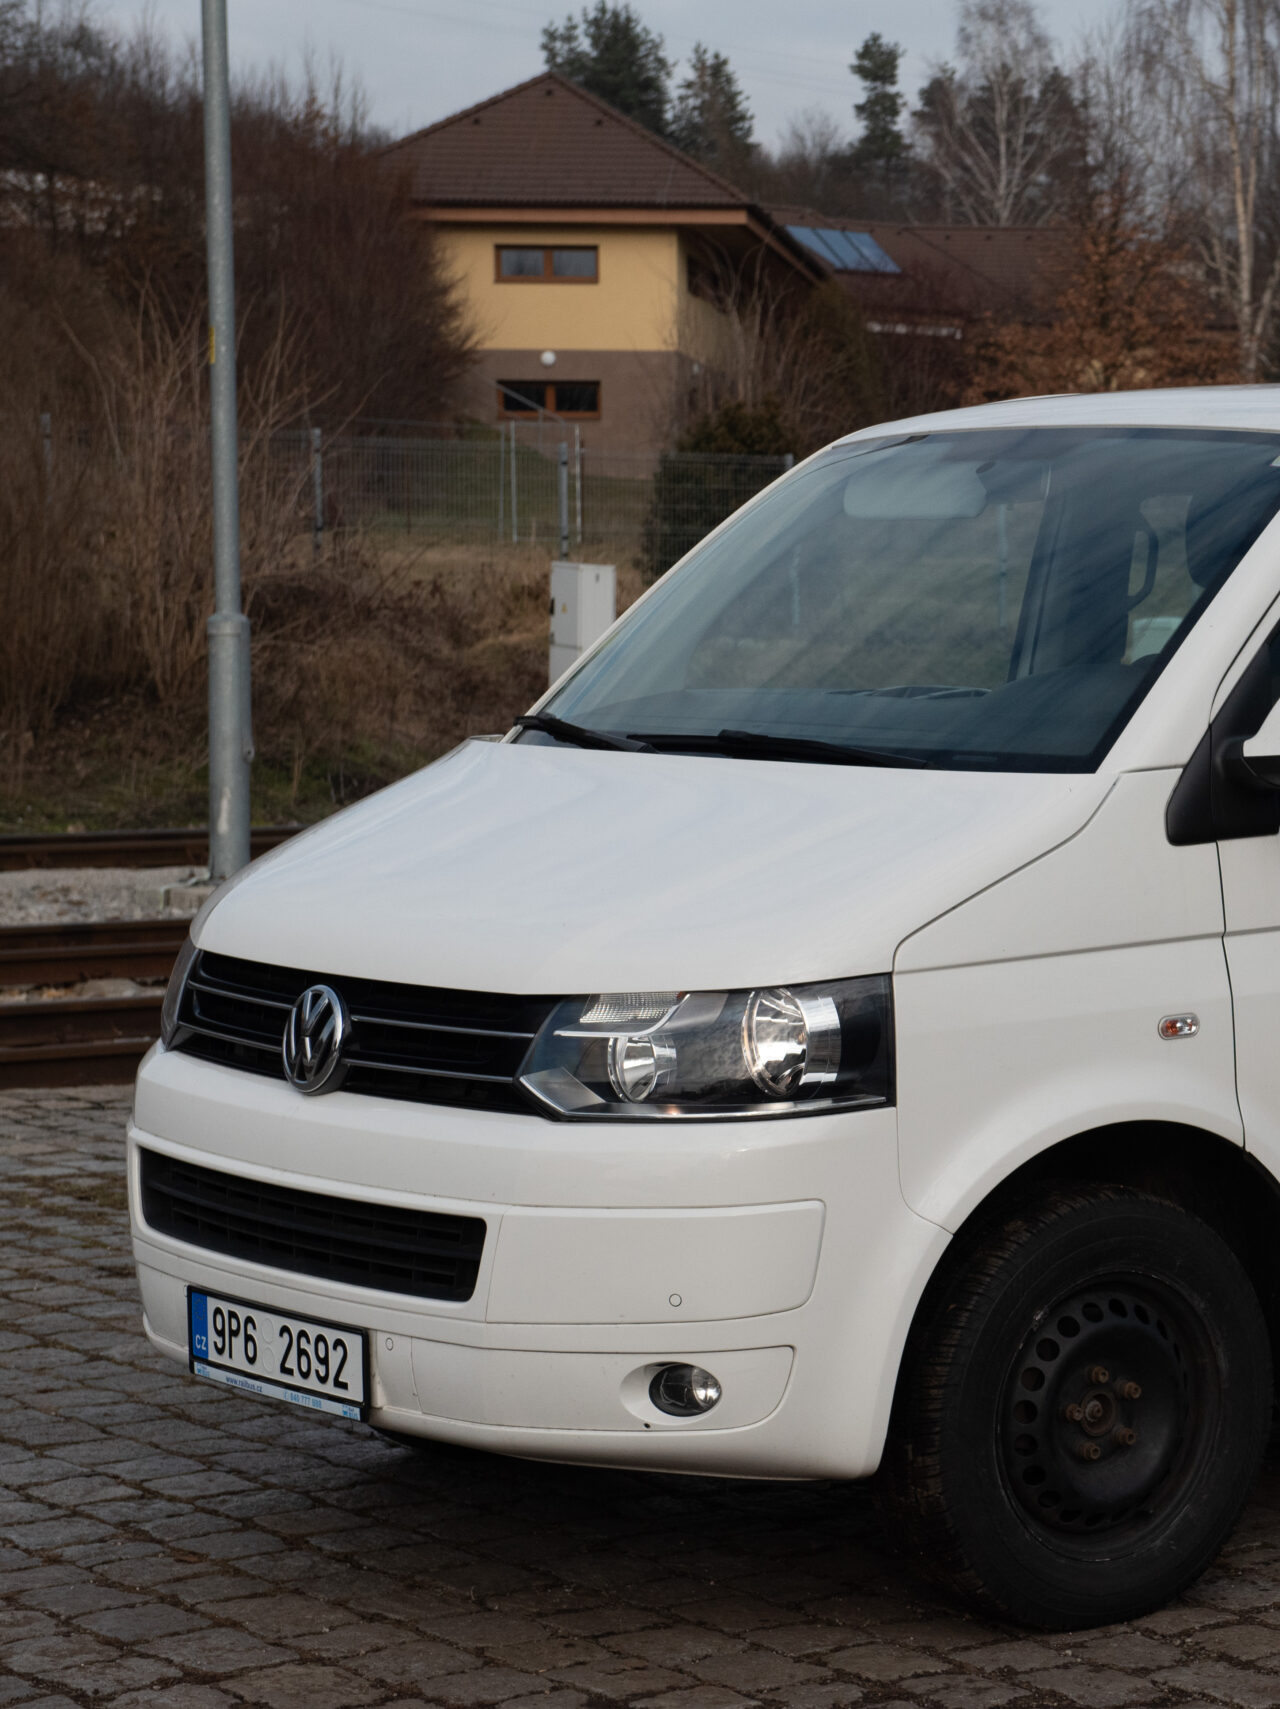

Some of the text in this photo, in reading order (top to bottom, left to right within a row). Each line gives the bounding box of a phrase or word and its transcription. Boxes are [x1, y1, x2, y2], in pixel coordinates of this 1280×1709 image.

[282, 983, 344, 1093] VW
[195, 1334, 207, 1351] CZ
[212, 1306, 349, 1391] 9P6 2692
[225, 1375, 263, 1393] www.railbus.cz
